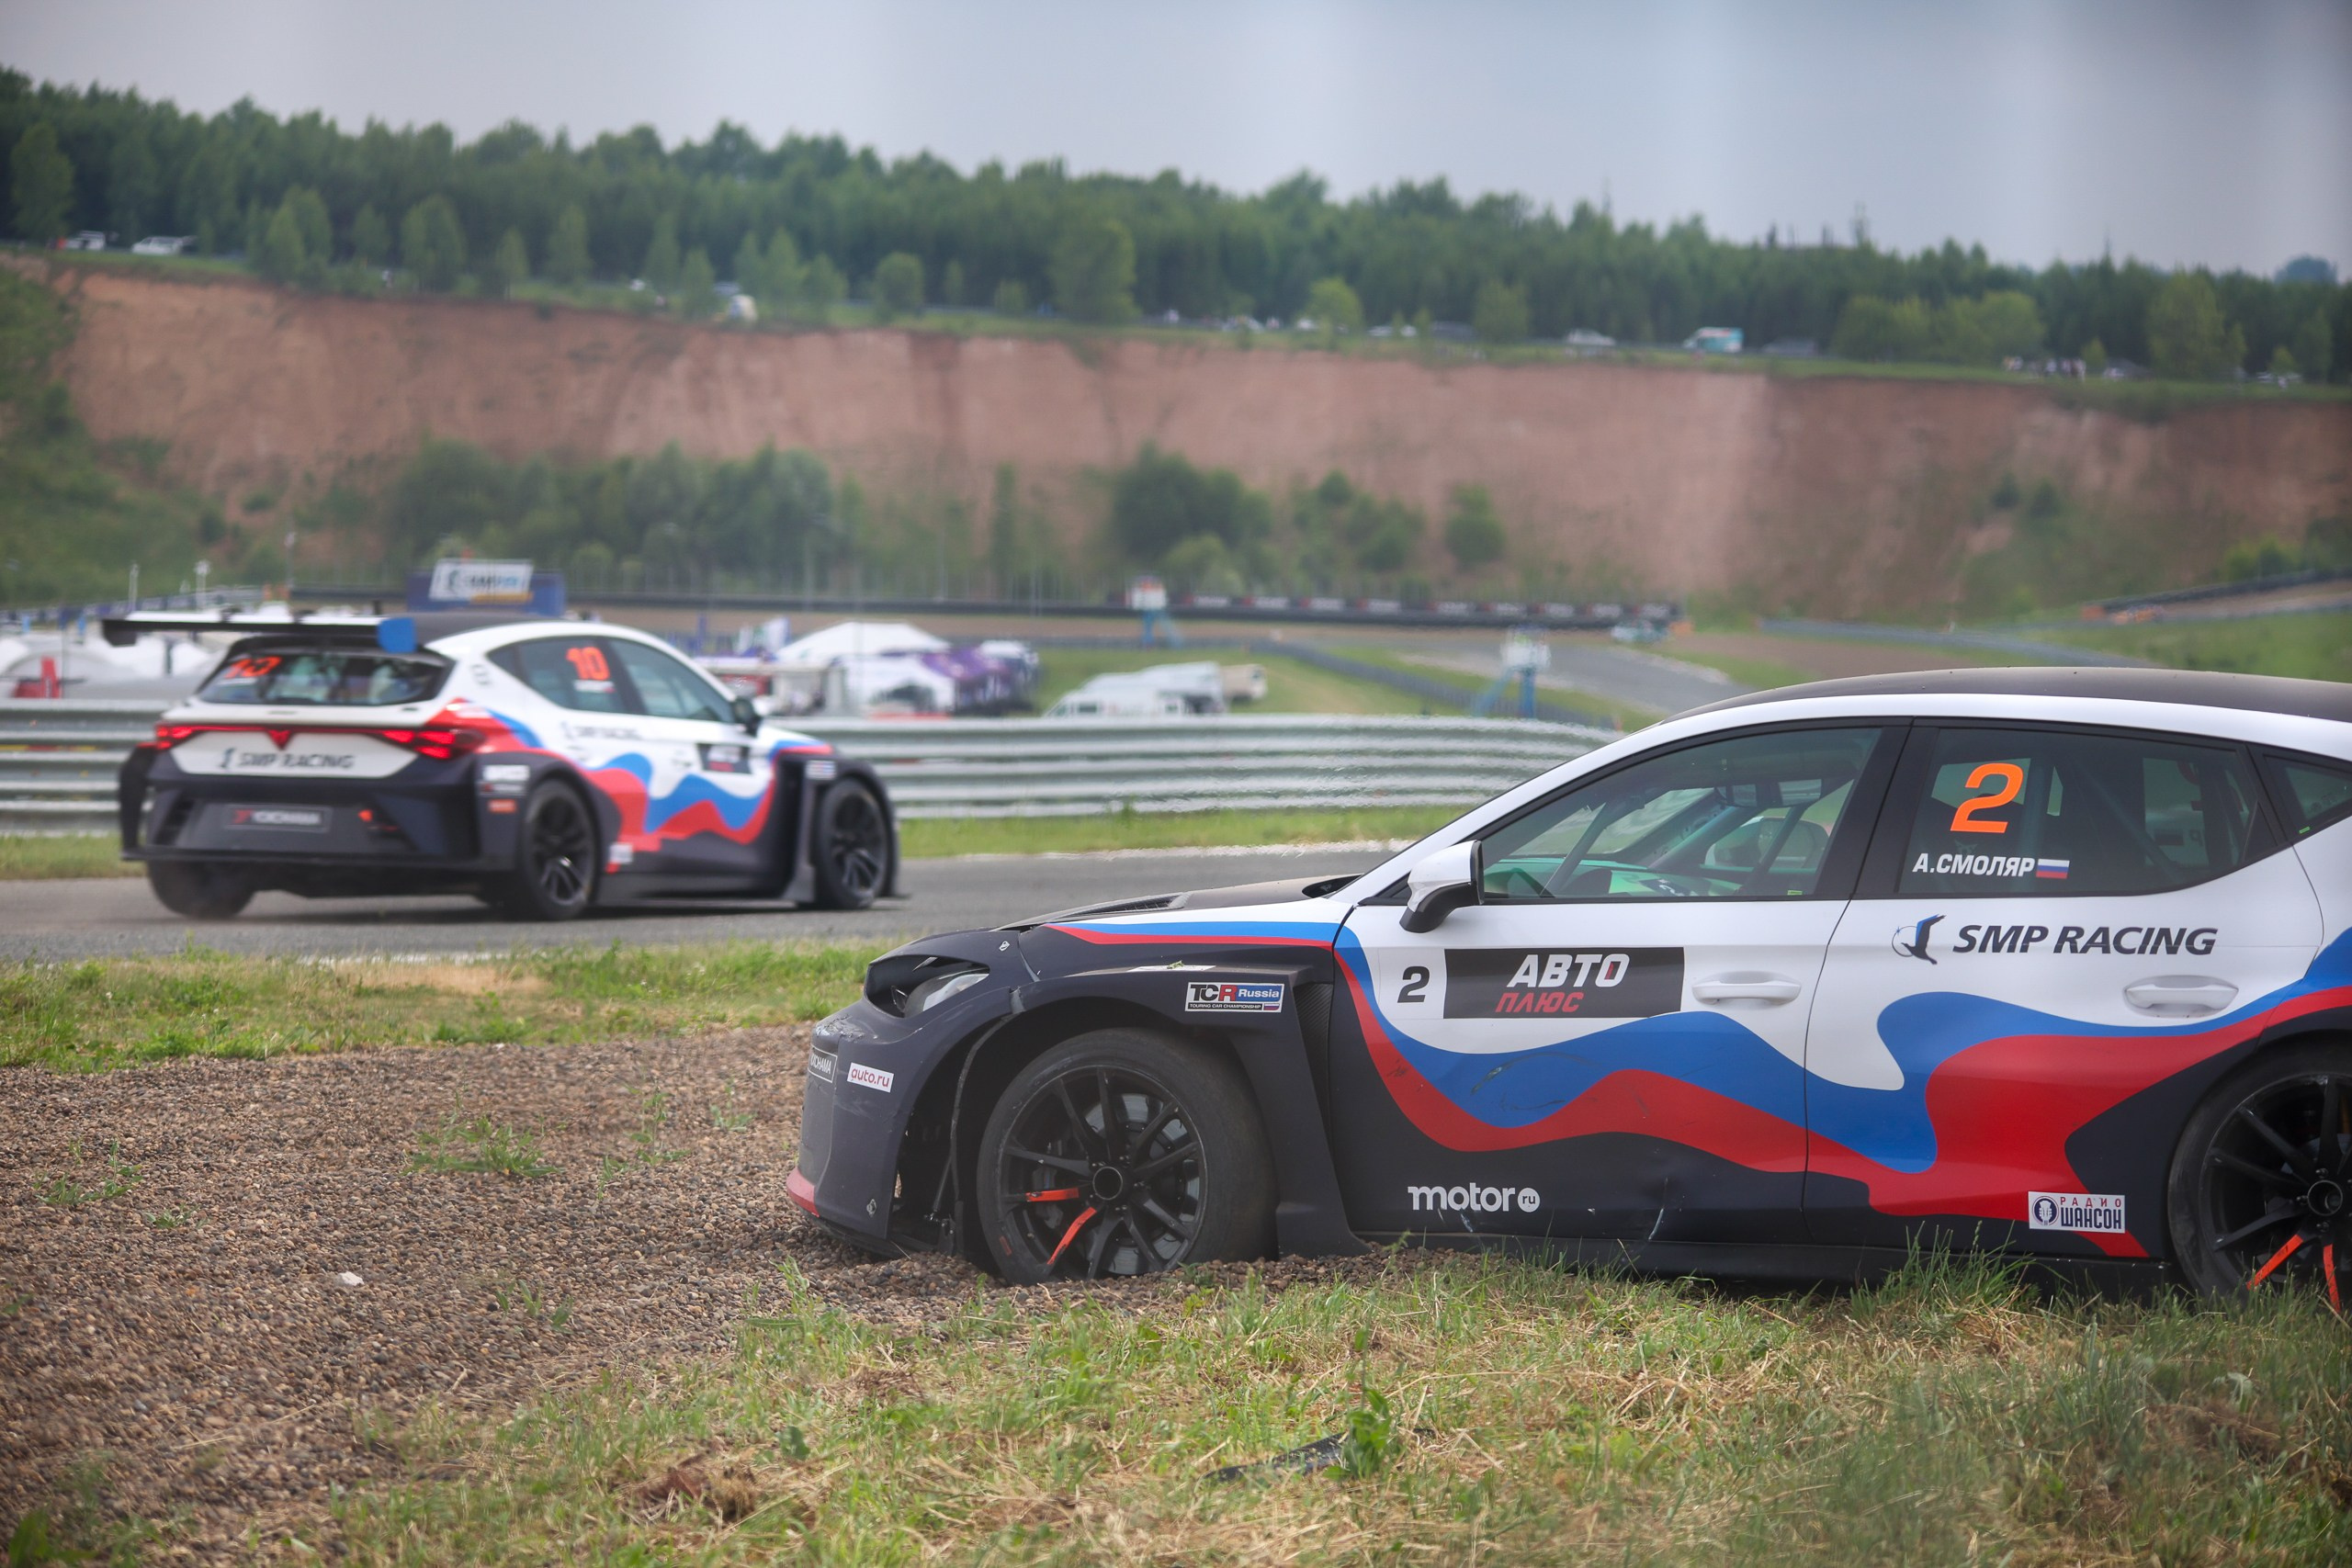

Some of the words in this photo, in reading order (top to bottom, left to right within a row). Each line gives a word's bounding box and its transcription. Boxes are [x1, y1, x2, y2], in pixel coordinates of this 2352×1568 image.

[1950, 762, 2024, 834] 2
[1912, 852, 2036, 877] А.СМОЛЯР
[1952, 924, 2050, 953] SMP
[2052, 926, 2219, 955] RACING
[1506, 953, 1630, 987] АВТО
[1191, 984, 1238, 1001] TCR
[1238, 988, 1280, 998] Russia
[1396, 965, 1430, 1003] 2
[1495, 991, 1585, 1013] ПЛЮС
[851, 1067, 890, 1088] auto.ru
[1408, 1182, 1516, 1213] motor
[1521, 1194, 1536, 1204] ru
[2060, 1197, 2122, 1208] РАДИО
[2060, 1207, 2122, 1229] ШАНСОН
